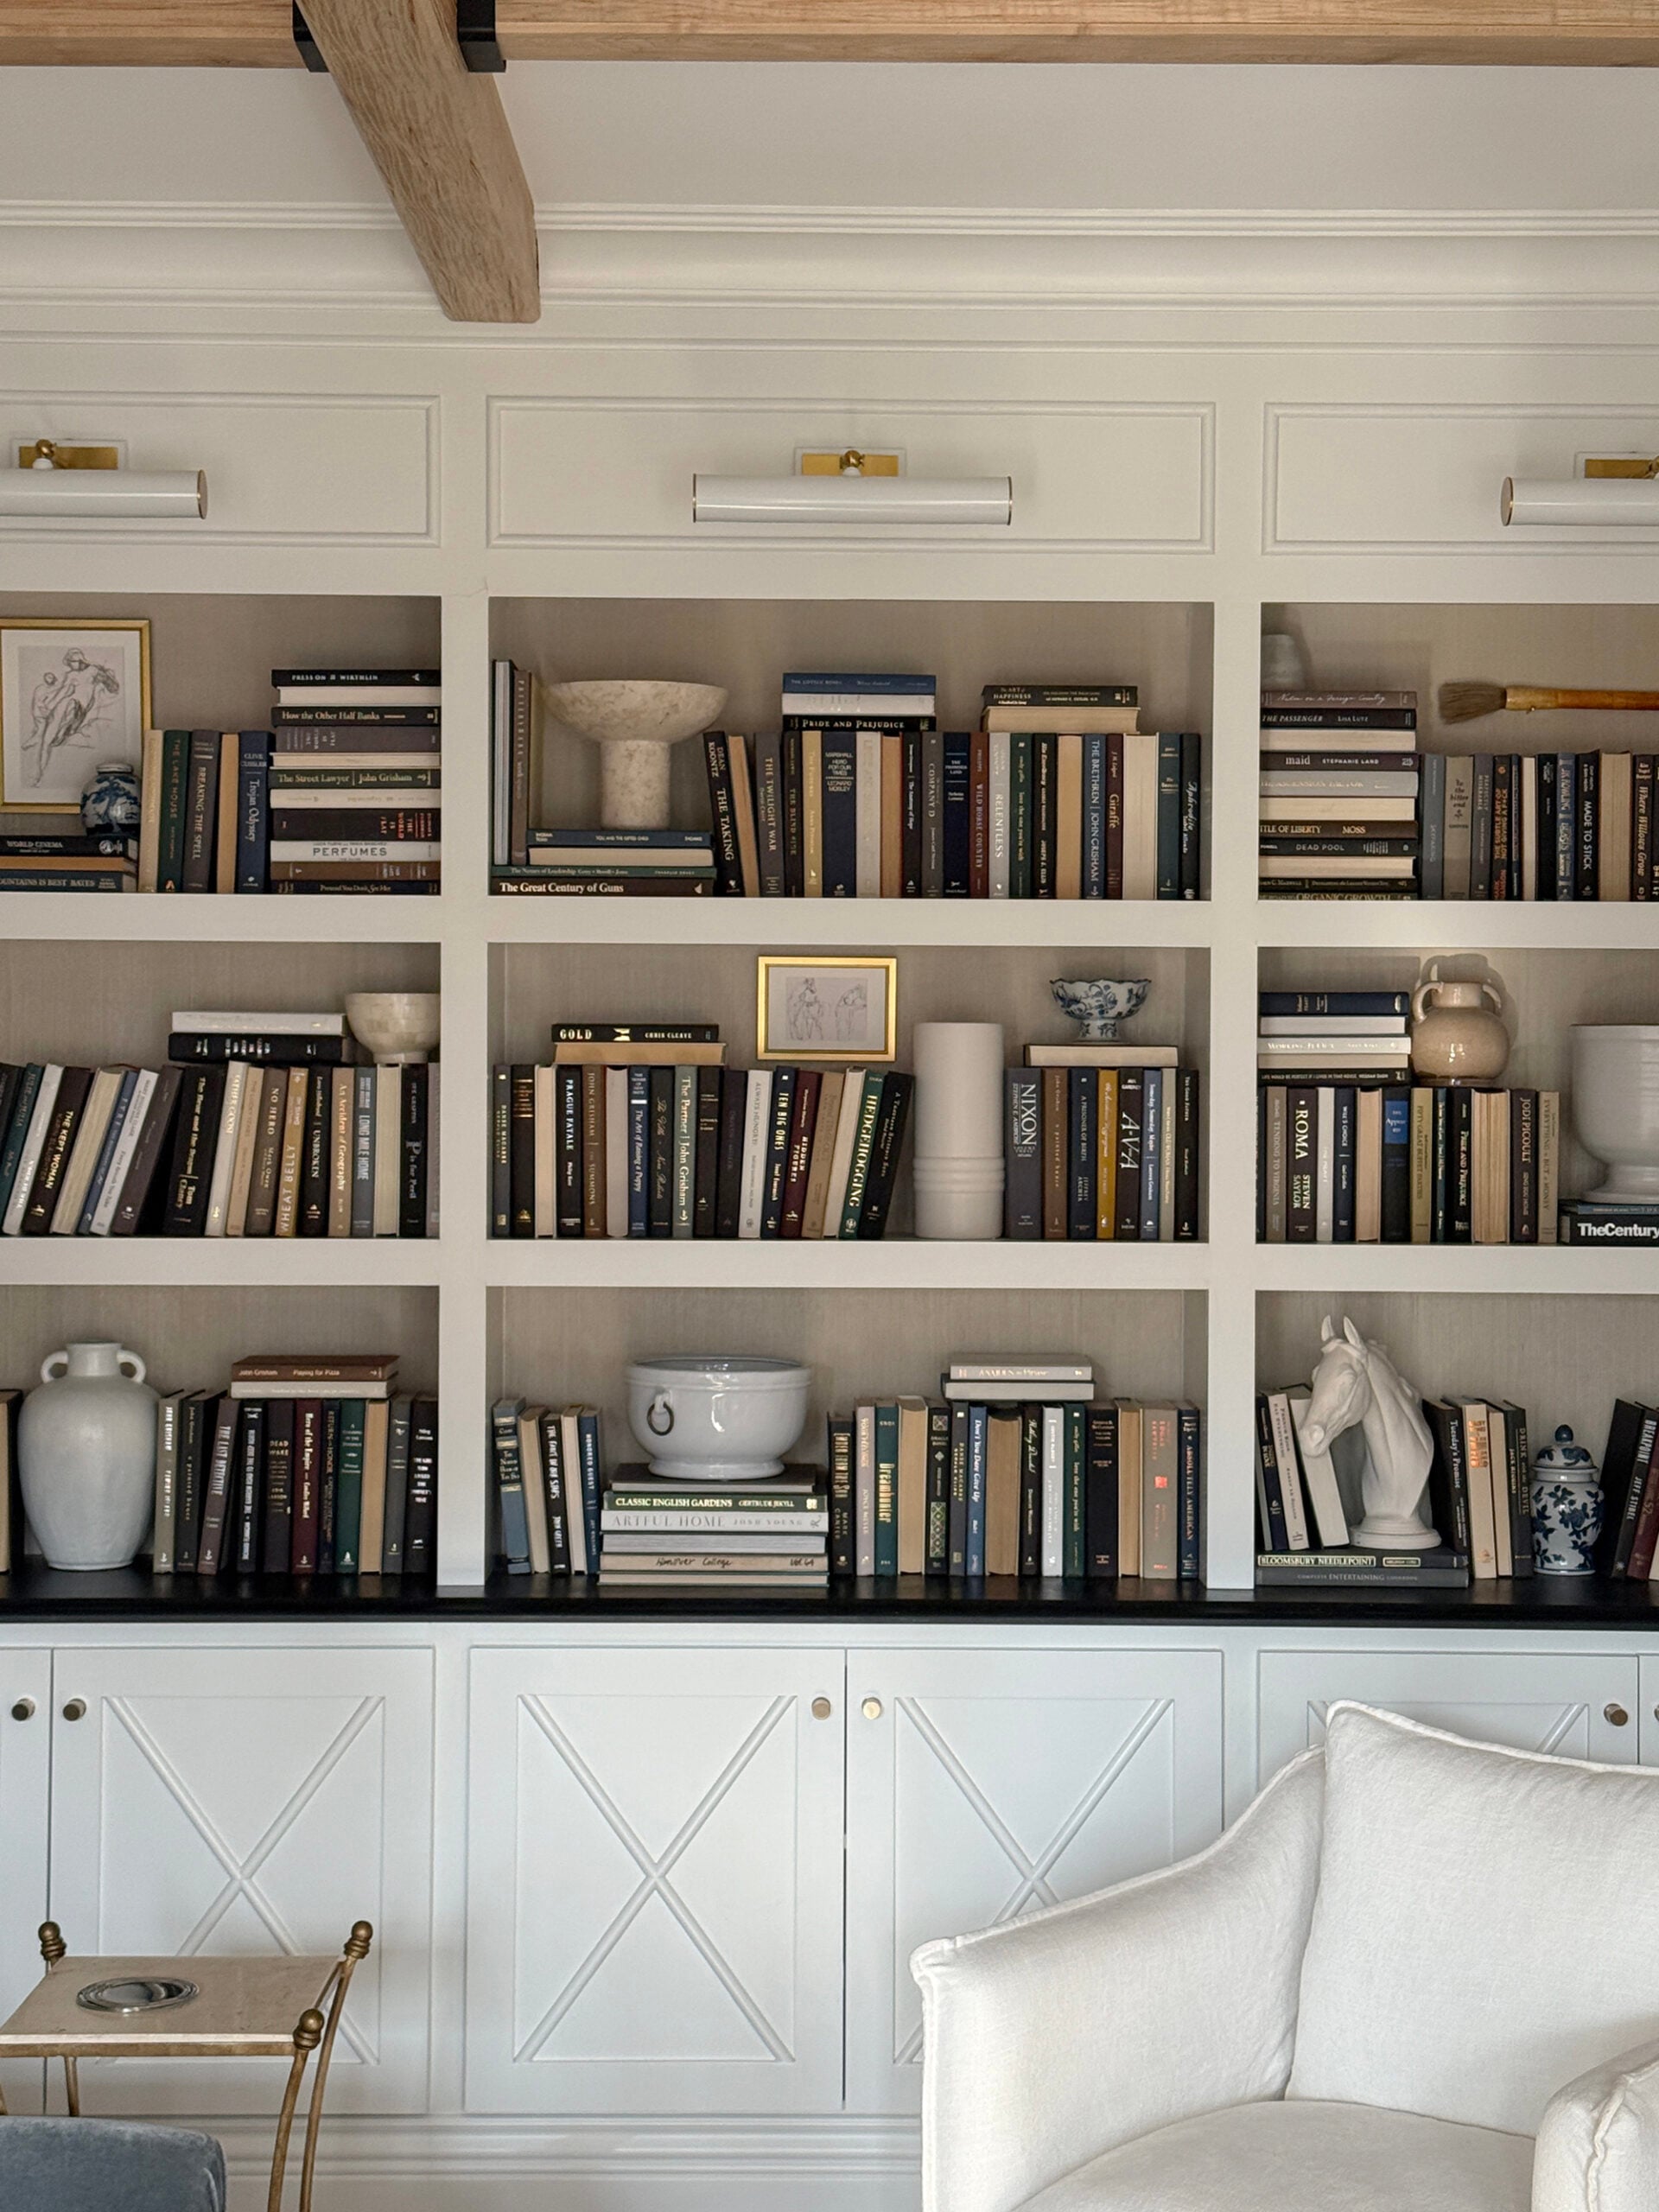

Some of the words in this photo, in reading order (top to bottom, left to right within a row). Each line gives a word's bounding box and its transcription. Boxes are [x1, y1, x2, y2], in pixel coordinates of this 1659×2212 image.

[282, 710, 299, 720] How
[301, 710, 314, 720] the
[315, 710, 338, 720] Other
[339, 709, 356, 720] Half
[357, 710, 380, 720] Banks
[1091, 740, 1100, 757] THE
[1285, 754, 1311, 765] maid
[295, 774, 319, 783] Street
[321, 774, 350, 785] Lawyer
[358, 774, 377, 785] John
[378, 773, 413, 782] Grisham
[766, 758, 774, 777] THE
[195, 766, 207, 811] BREAKING
[247, 779, 261, 805] Trojan
[1091, 759, 1100, 804] BRETHREN
[716, 787, 728, 813] THE
[766, 779, 776, 827] TWILIGHT
[1108, 793, 1120, 829] Giraffe
[1185, 782, 1198, 831] Aphrodite
[1638, 786, 1649, 813] Where
[194, 814, 204, 832] THE
[995, 793, 1004, 858] RELENTLESS
[1090, 811, 1099, 837] JOHN
[1584, 800, 1592, 827] MADE
[721, 815, 735, 861] TAKING
[1342, 825, 1366, 834] MOSS
[1583, 829, 1592, 842] TO
[1637, 816, 1648, 850] Willows
[35, 840, 64, 849] CINEMA
[192, 834, 203, 861] SPELL
[313, 848, 388, 857] PERFUMES
[1583, 844, 1592, 870] STICK
[1637, 852, 1647, 876] Grow
[499, 881, 517, 893] The
[518, 881, 546, 893] Great
[547, 882, 585, 896] Century
[586, 882, 596, 893] of
[598, 882, 625, 894] Guns
[559, 1028, 592, 1040] GOLD
[270, 1087, 279, 1103] NO
[588, 1072, 596, 1096] JOHN
[681, 1076, 691, 1096] The
[565, 1079, 574, 1115] PRAGUE
[779, 1092, 789, 1108] TEN
[1520, 1097, 1531, 1121] JODI
[62, 1110, 74, 1127] THE
[267, 1106, 277, 1135] HERO
[338, 1098, 347, 1135] Accident
[358, 1115, 371, 1136] LONG
[681, 1099, 690, 1134] Partner
[777, 1111, 788, 1126] BIG
[1020, 1083, 1037, 1147] NIXON
[54, 1128, 69, 1152] KEPT
[565, 1117, 574, 1151] FATALE
[774, 1129, 785, 1151] ONES
[1272, 1121, 1281, 1157] TENDING
[1295, 1109, 1309, 1160] ROMA
[1521, 1122, 1531, 1163] PICOULT
[310, 1129, 321, 1178] UNBROKEN
[358, 1137, 370, 1156] MILE
[633, 1142, 643, 1165] Raising
[678, 1141, 690, 1164] John
[798, 1135, 809, 1172] HIDDEN
[849, 1094, 878, 1207] HEDGEHOGGING
[44, 1154, 62, 1189] WOMAN
[284, 1145, 296, 1183] BELLY
[337, 1144, 346, 1192] Geography
[357, 1157, 369, 1180] HOME
[790, 1144, 800, 1183] FIGURES
[1272, 1159, 1280, 1170] TO
[633, 1171, 643, 1192] Puppy
[678, 1166, 690, 1206] Grisham
[1293, 1175, 1301, 1209] SAYLOR
[1302, 1174, 1311, 1210] STEVEN
[186, 1185, 196, 1205] Tom
[280, 1188, 290, 1232] WHEAT
[218, 1426, 232, 1439] THE
[974, 1419, 983, 1440] Don't
[1448, 1420, 1460, 1456] Tuesday's
[1636, 1419, 1657, 1464] BREAKPOINT
[216, 1441, 230, 1458] LAST
[585, 1433, 594, 1465] HONORED
[973, 1440, 982, 1454] You
[973, 1454, 982, 1471] Dare
[1452, 1458, 1462, 1489] Promise
[587, 1467, 595, 1490] GUEST
[973, 1472, 982, 1491] Give
[1632, 1476, 1643, 1493] JEFF
[615, 1497, 651, 1507] CLASSIC
[652, 1497, 690, 1507] ENGLISH
[690, 1498, 733, 1508] GARDENS
[878, 1463, 896, 1523] Dreamhunter
[971, 1491, 981, 1503] Up
[613, 1515, 673, 1527] ARTFUL
[678, 1515, 725, 1527] HOME
[1261, 1555, 1315, 1566] BLOOMSBURY
[1318, 1556, 1372, 1567] NEEDLEPOINT
